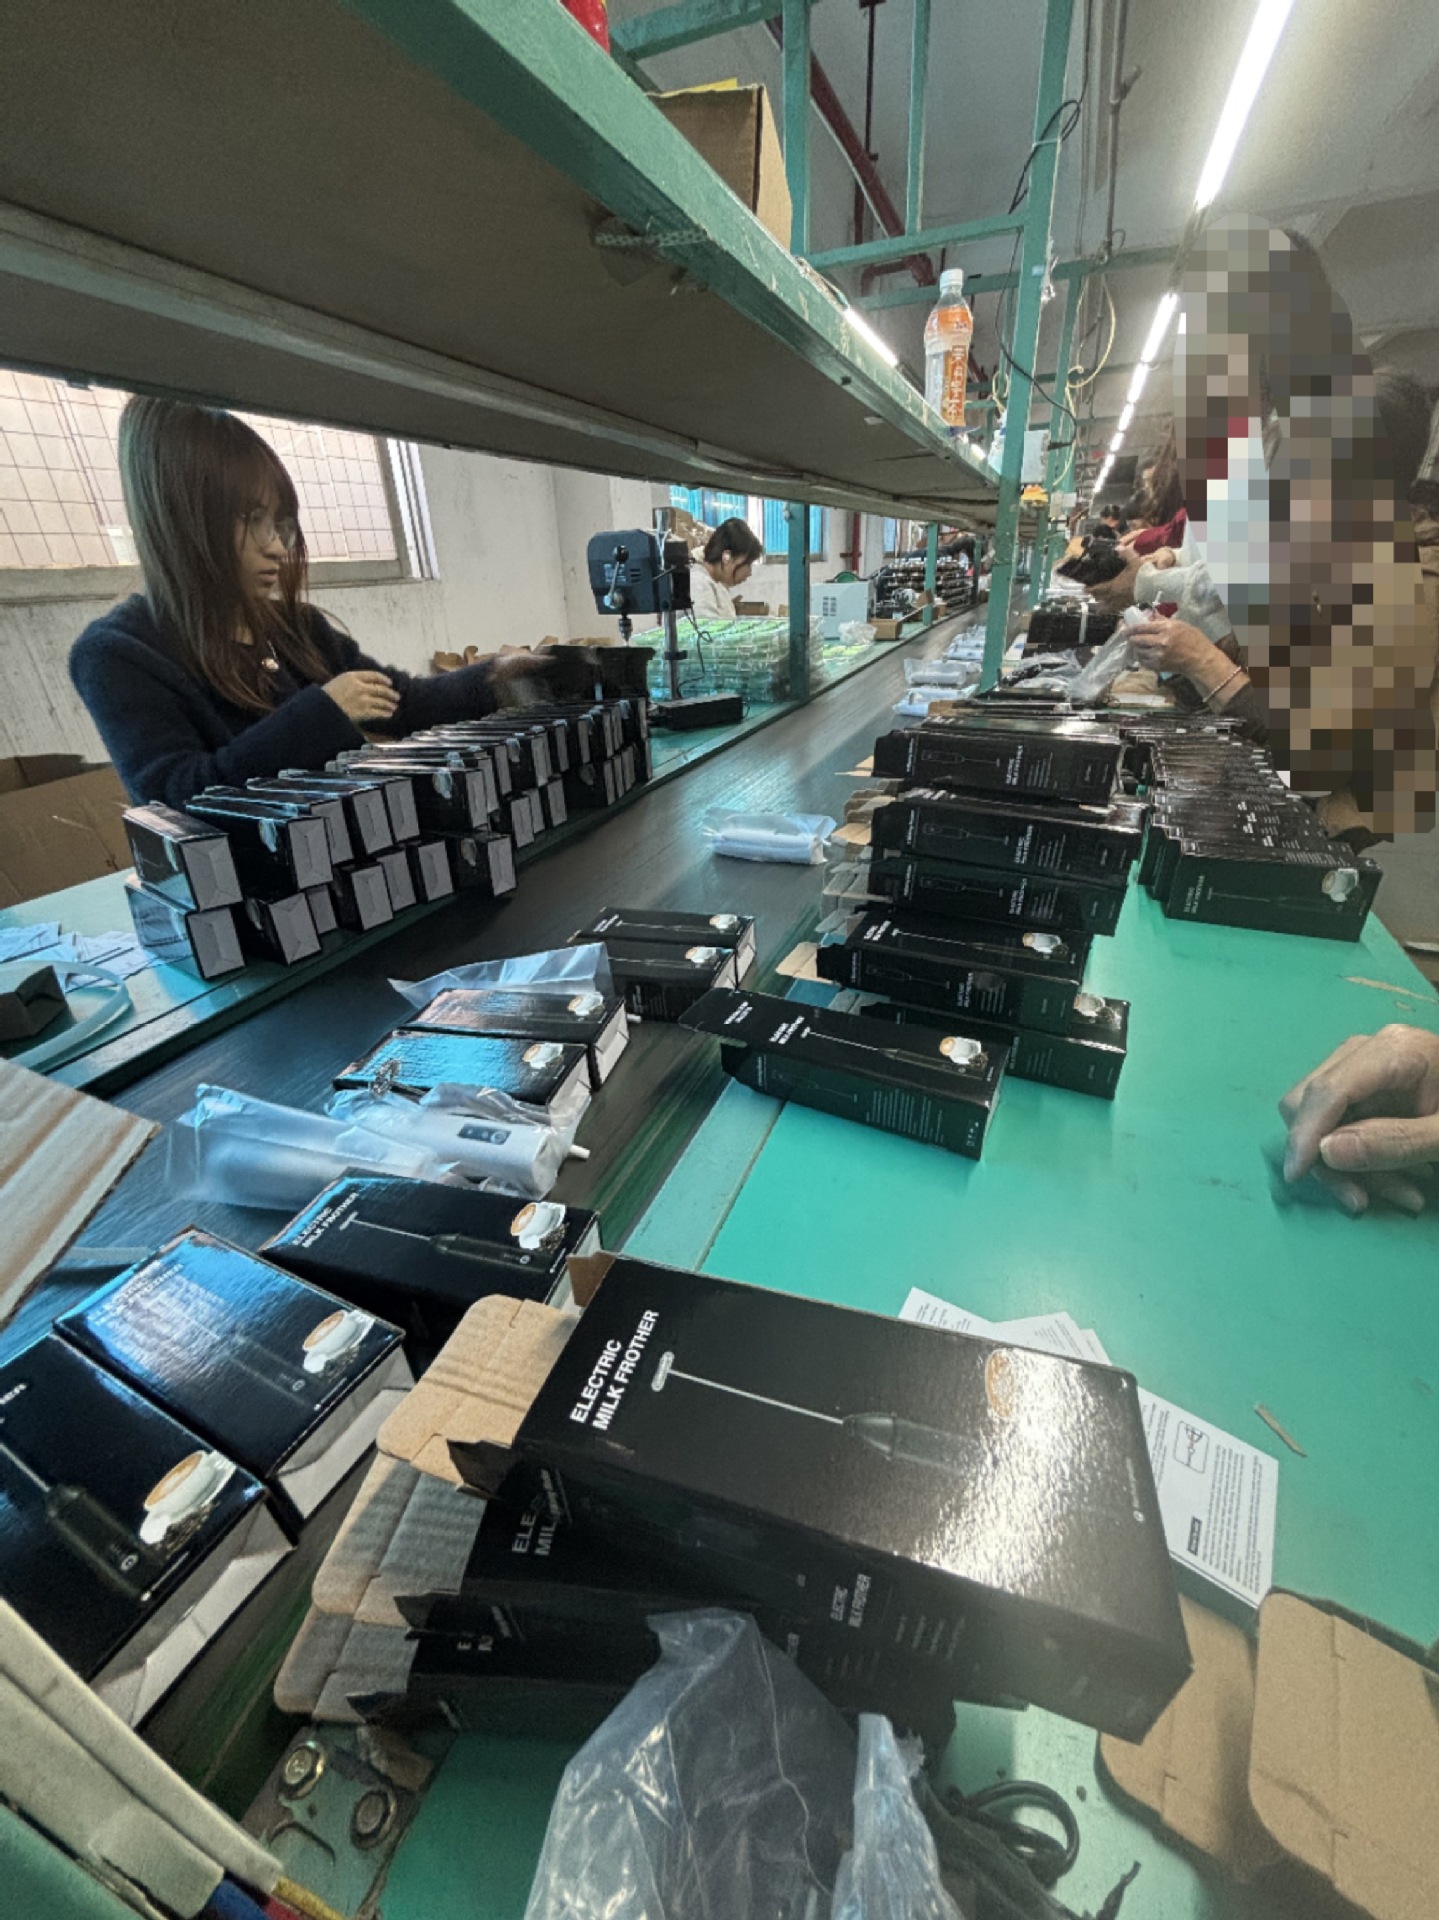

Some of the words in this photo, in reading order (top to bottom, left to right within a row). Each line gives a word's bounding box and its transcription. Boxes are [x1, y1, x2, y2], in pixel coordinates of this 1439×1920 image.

[569, 1339, 622, 1423] ELECTRIC
[592, 1384, 625, 1431] MILK
[614, 1309, 660, 1384] FROTHER
